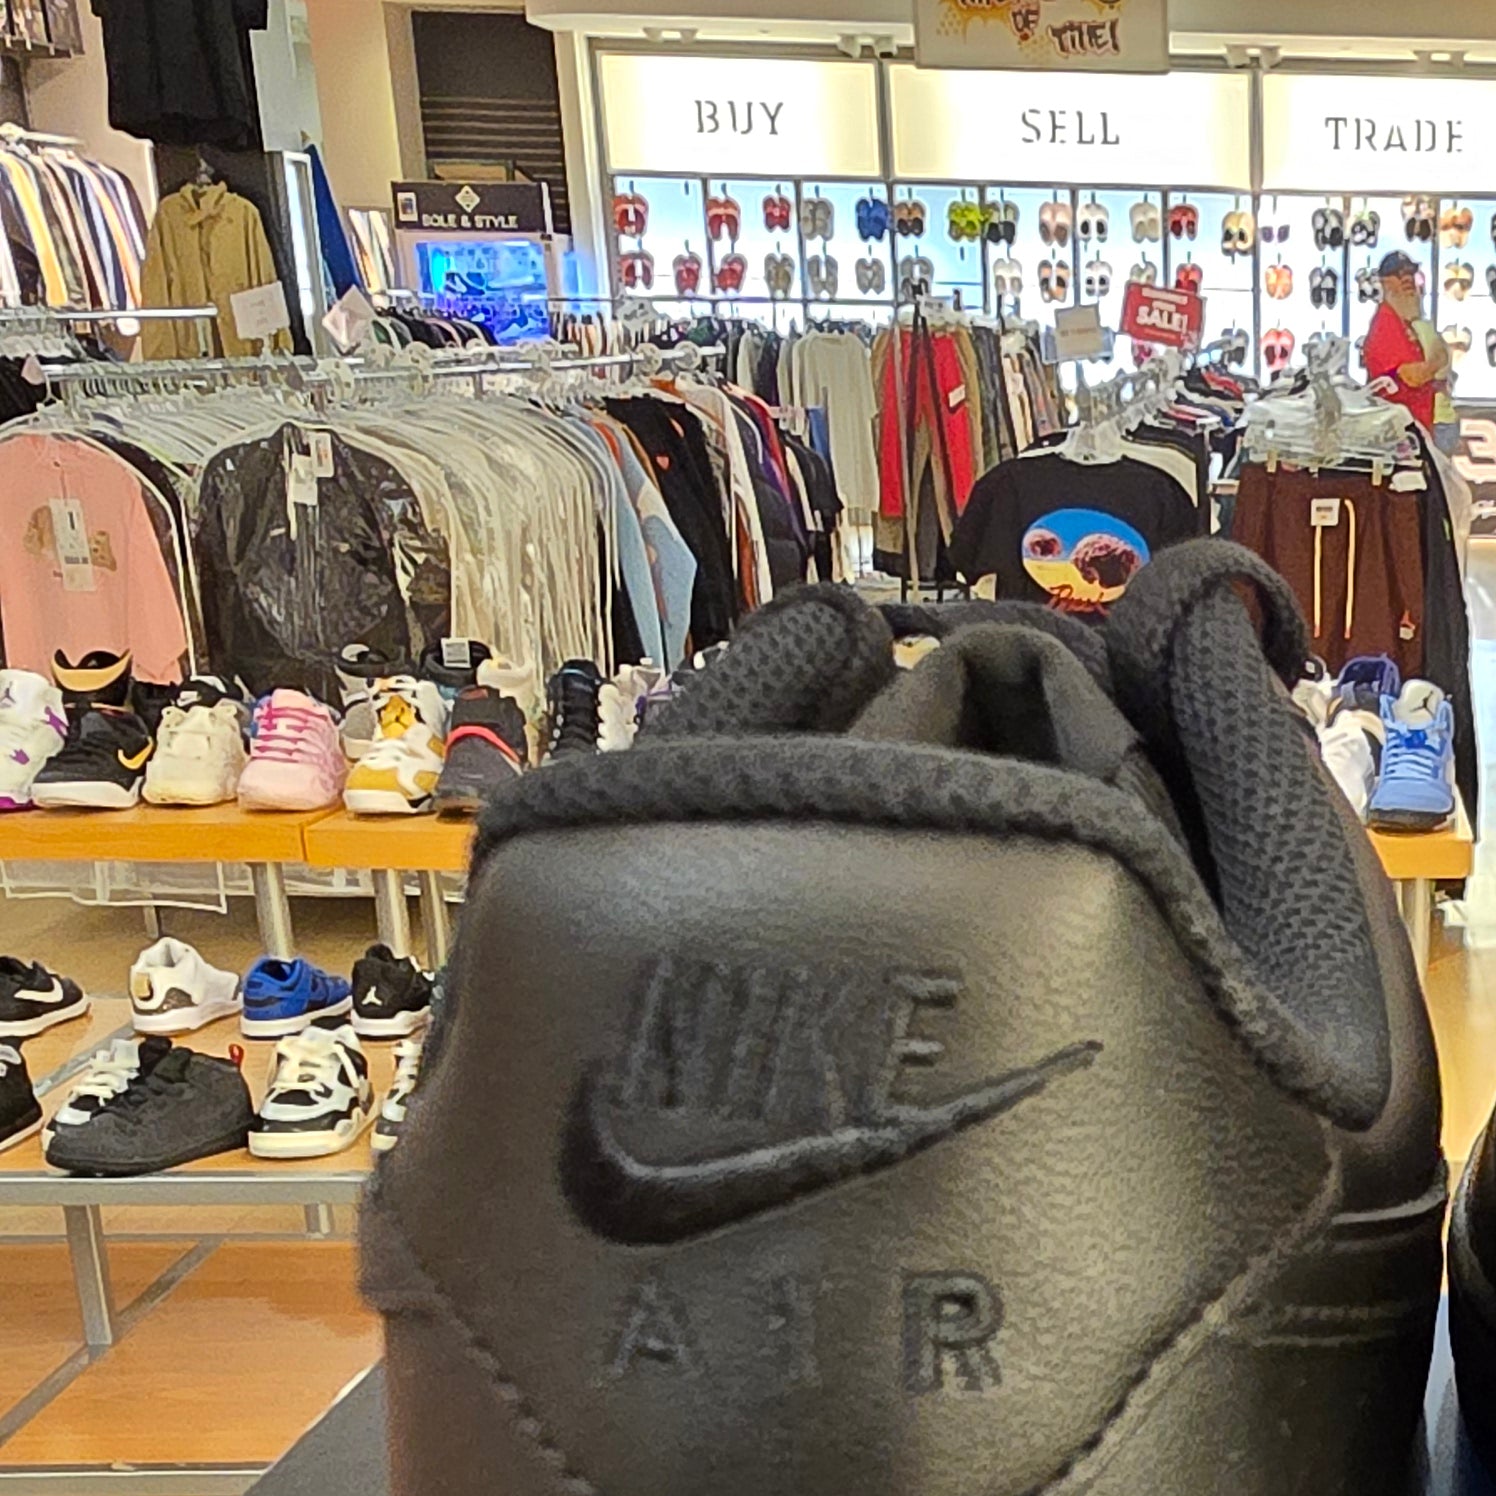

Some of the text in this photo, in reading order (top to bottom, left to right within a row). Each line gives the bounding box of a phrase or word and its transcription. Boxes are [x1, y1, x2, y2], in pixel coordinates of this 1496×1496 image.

[694, 99, 784, 135] BUY
[1021, 108, 1120, 145] SELL
[1324, 116, 1463, 153] TRADE
[474, 214, 518, 229] STYLE
[615, 955, 966, 1123] NIKE
[596, 1268, 1003, 1395] AIR
